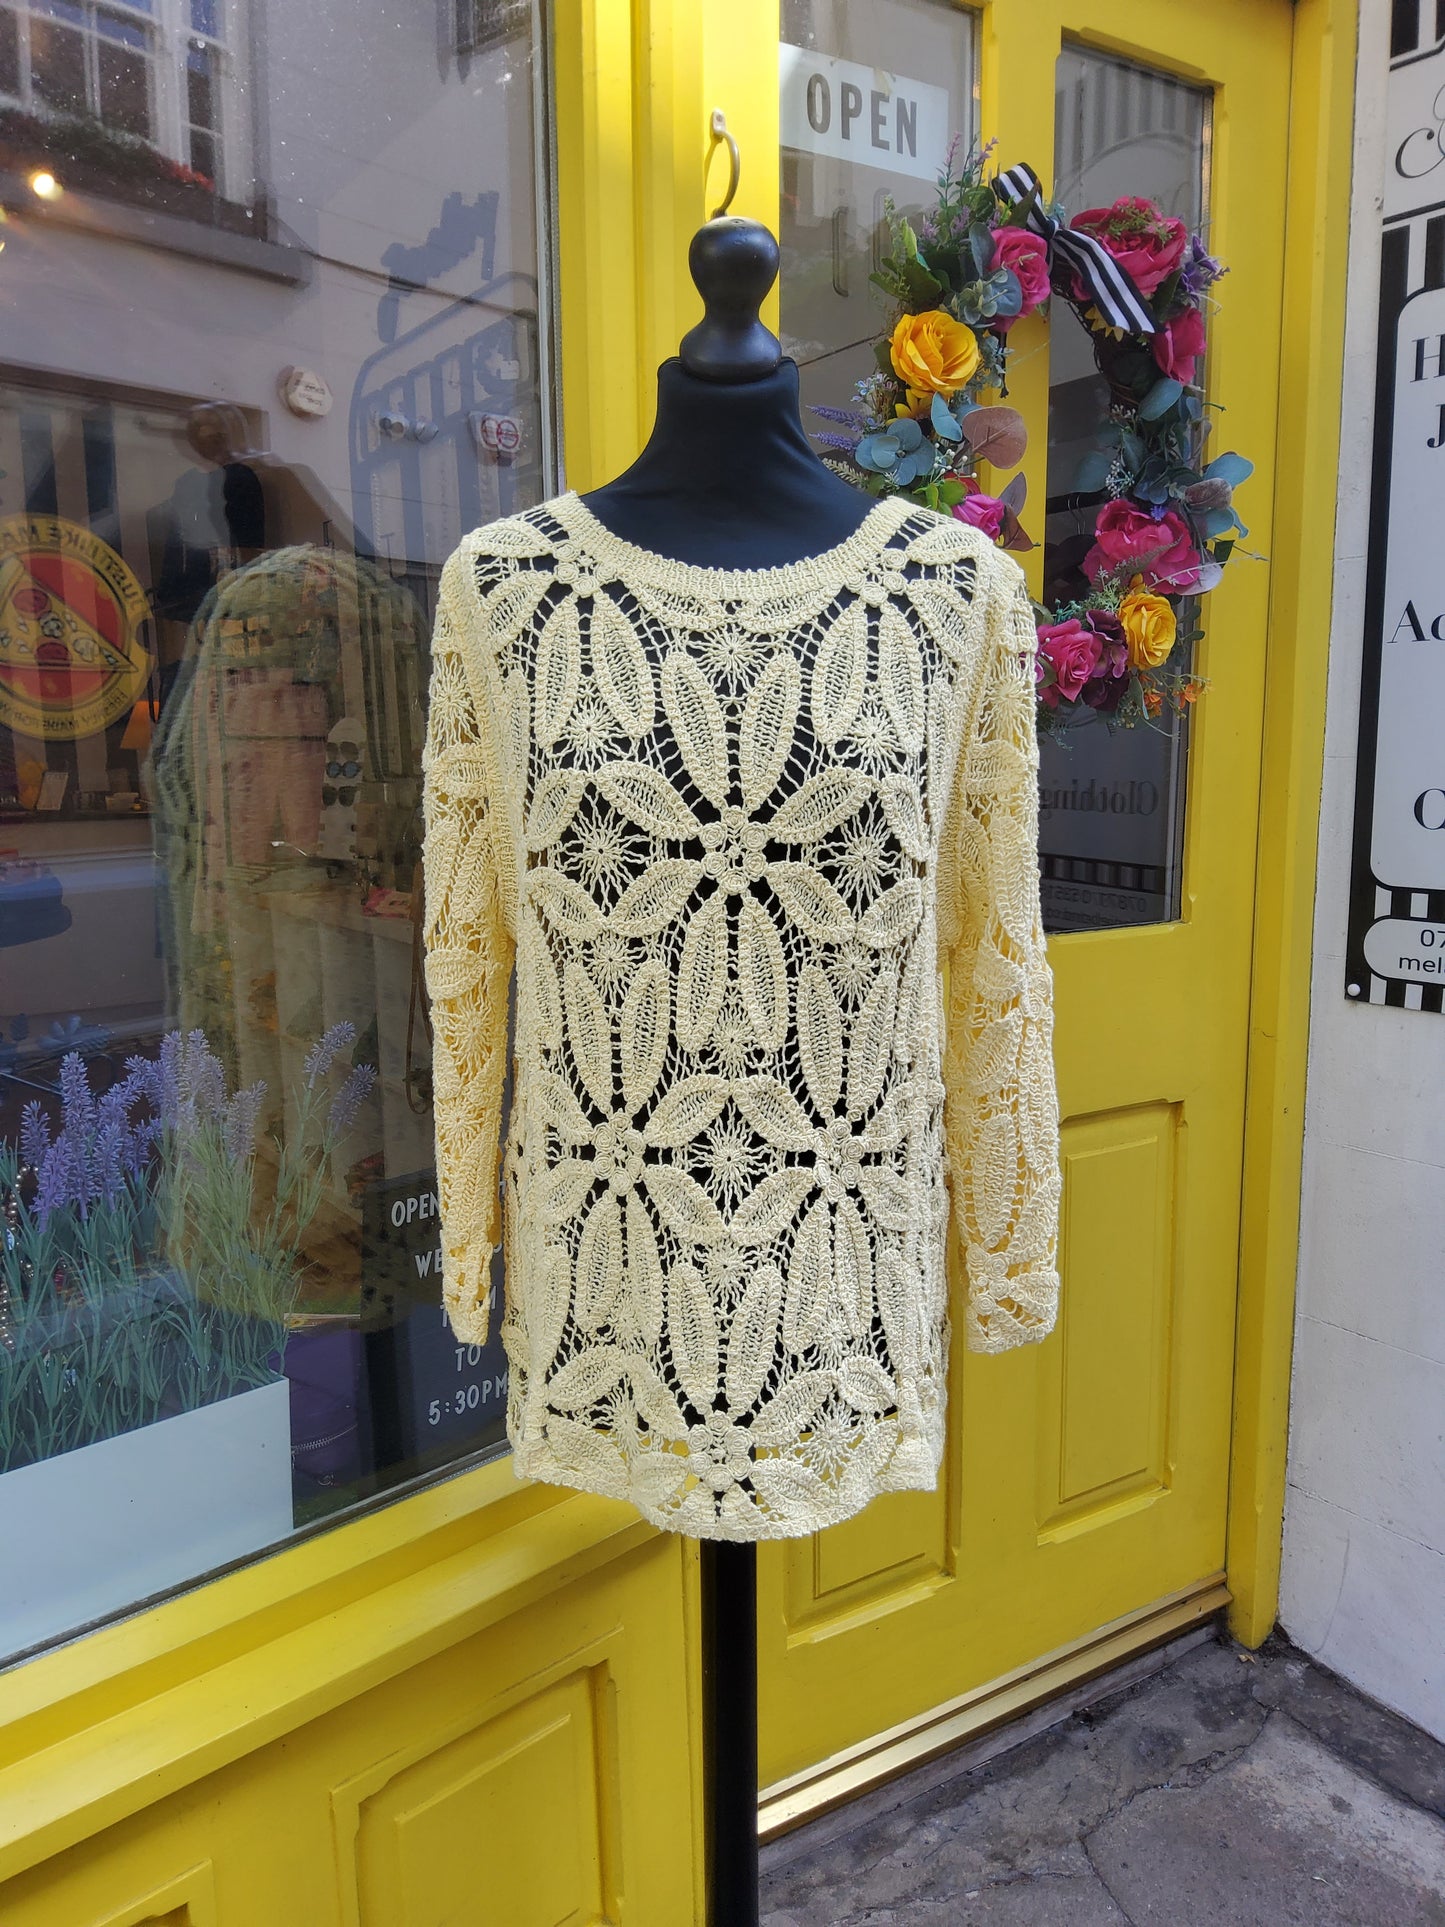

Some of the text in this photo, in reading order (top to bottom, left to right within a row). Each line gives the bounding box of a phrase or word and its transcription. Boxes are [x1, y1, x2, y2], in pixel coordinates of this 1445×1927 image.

[807, 73, 917, 158] OPEN
[455, 1344, 481, 1372] TO
[428, 1371, 508, 1425] 5:30PM
